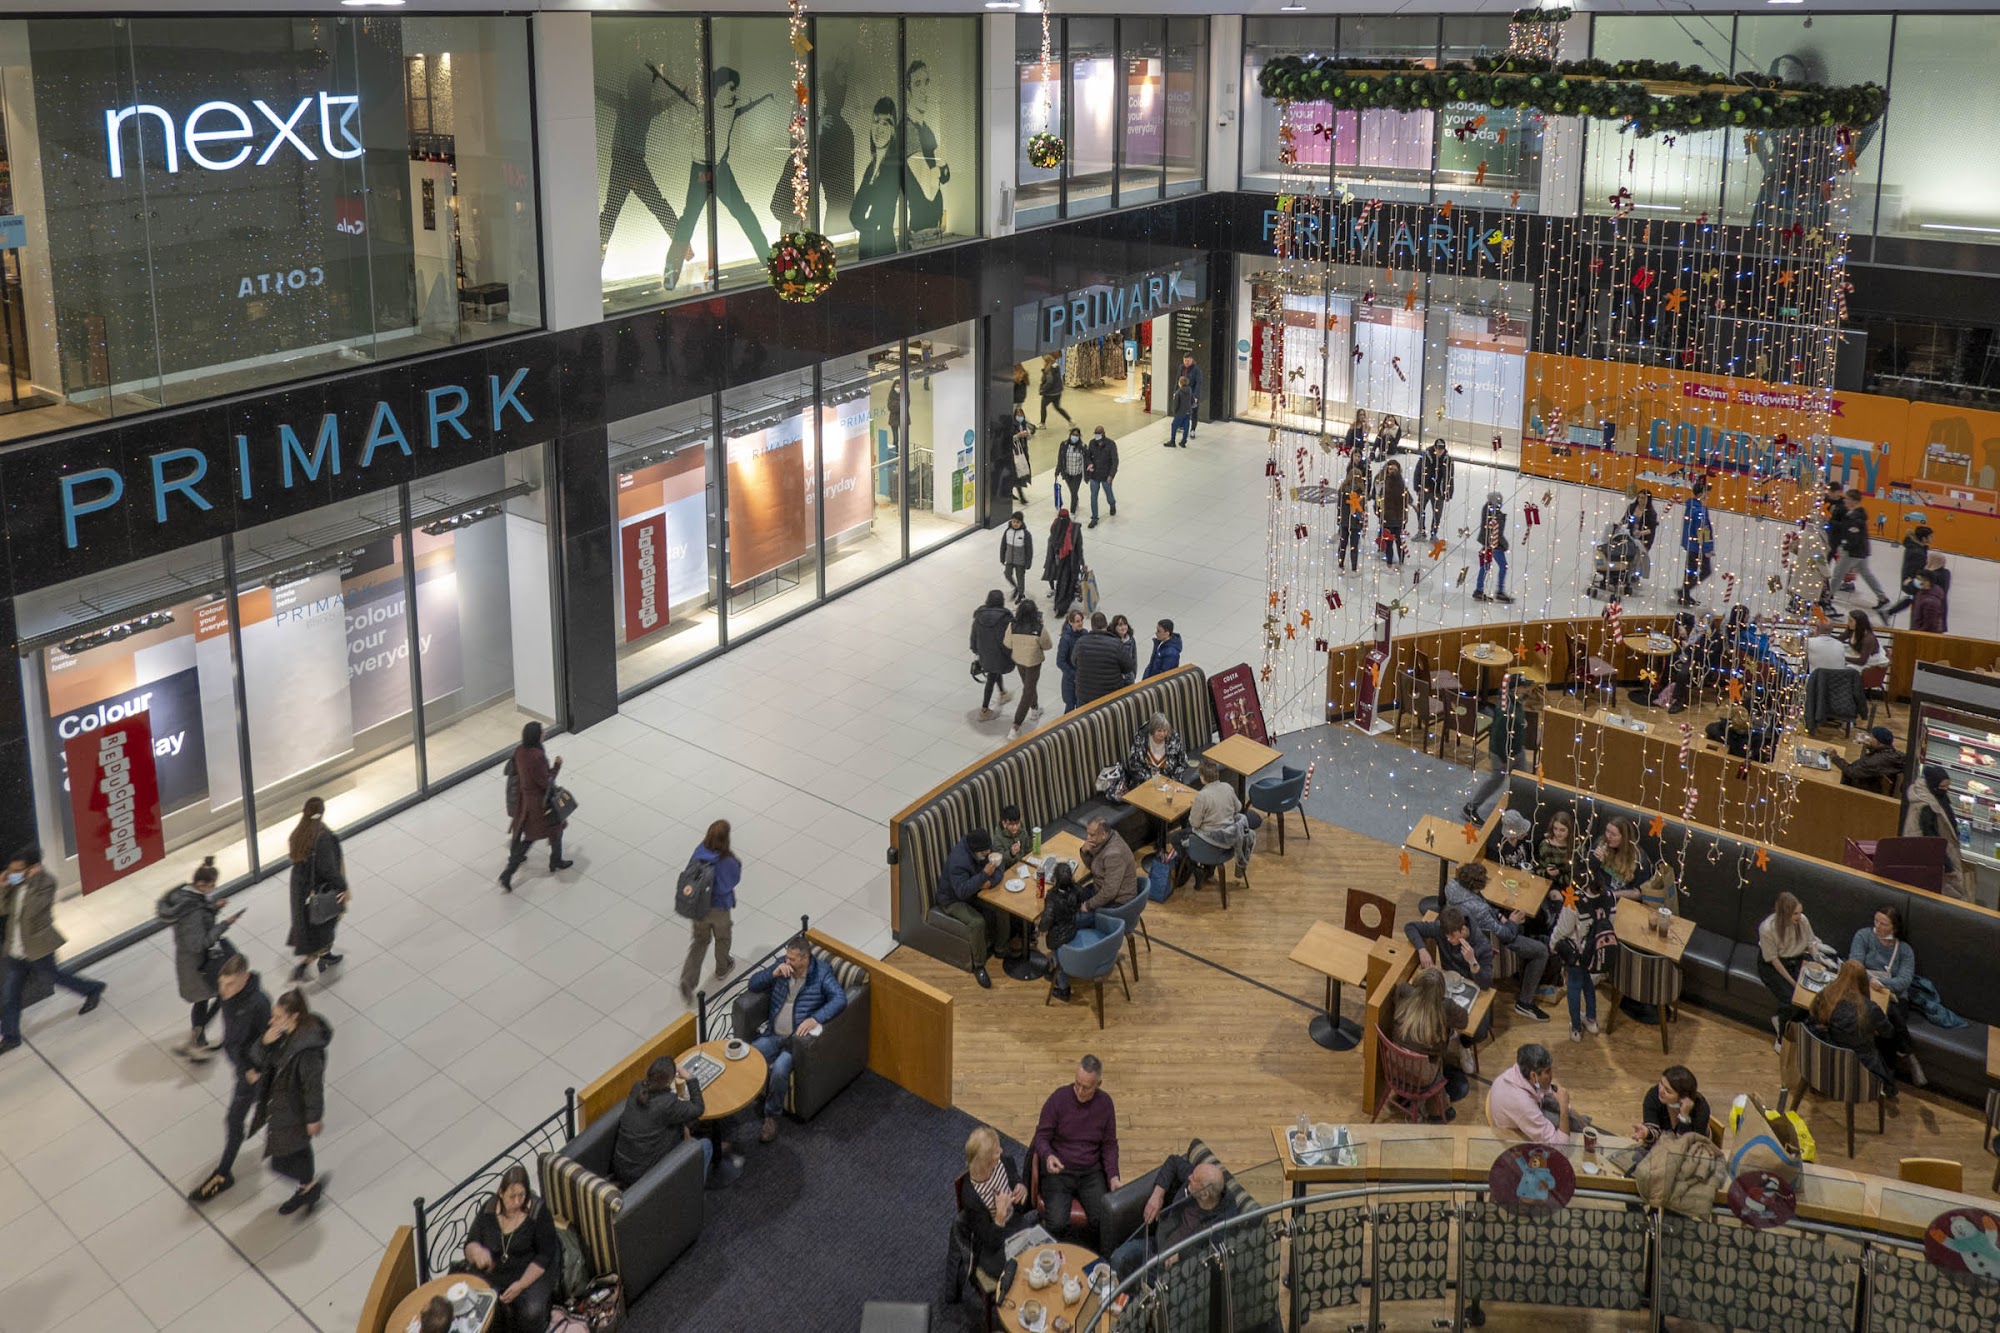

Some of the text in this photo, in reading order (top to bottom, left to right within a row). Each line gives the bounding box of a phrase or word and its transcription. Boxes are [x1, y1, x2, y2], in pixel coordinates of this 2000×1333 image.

[104, 91, 366, 178] next
[1263, 210, 1496, 263] PRIMARK
[1048, 271, 1182, 343] PRIMARK
[60, 367, 535, 549] PRIMARK
[640, 527, 656, 626] REDUCTIONS
[199, 605, 225, 617] Colour
[200, 615, 217, 627] your
[51, 653, 77, 664] mad
[52, 659, 78, 672] better
[59, 692, 153, 739] Colour
[103, 734, 136, 867] REDUCTIONS
